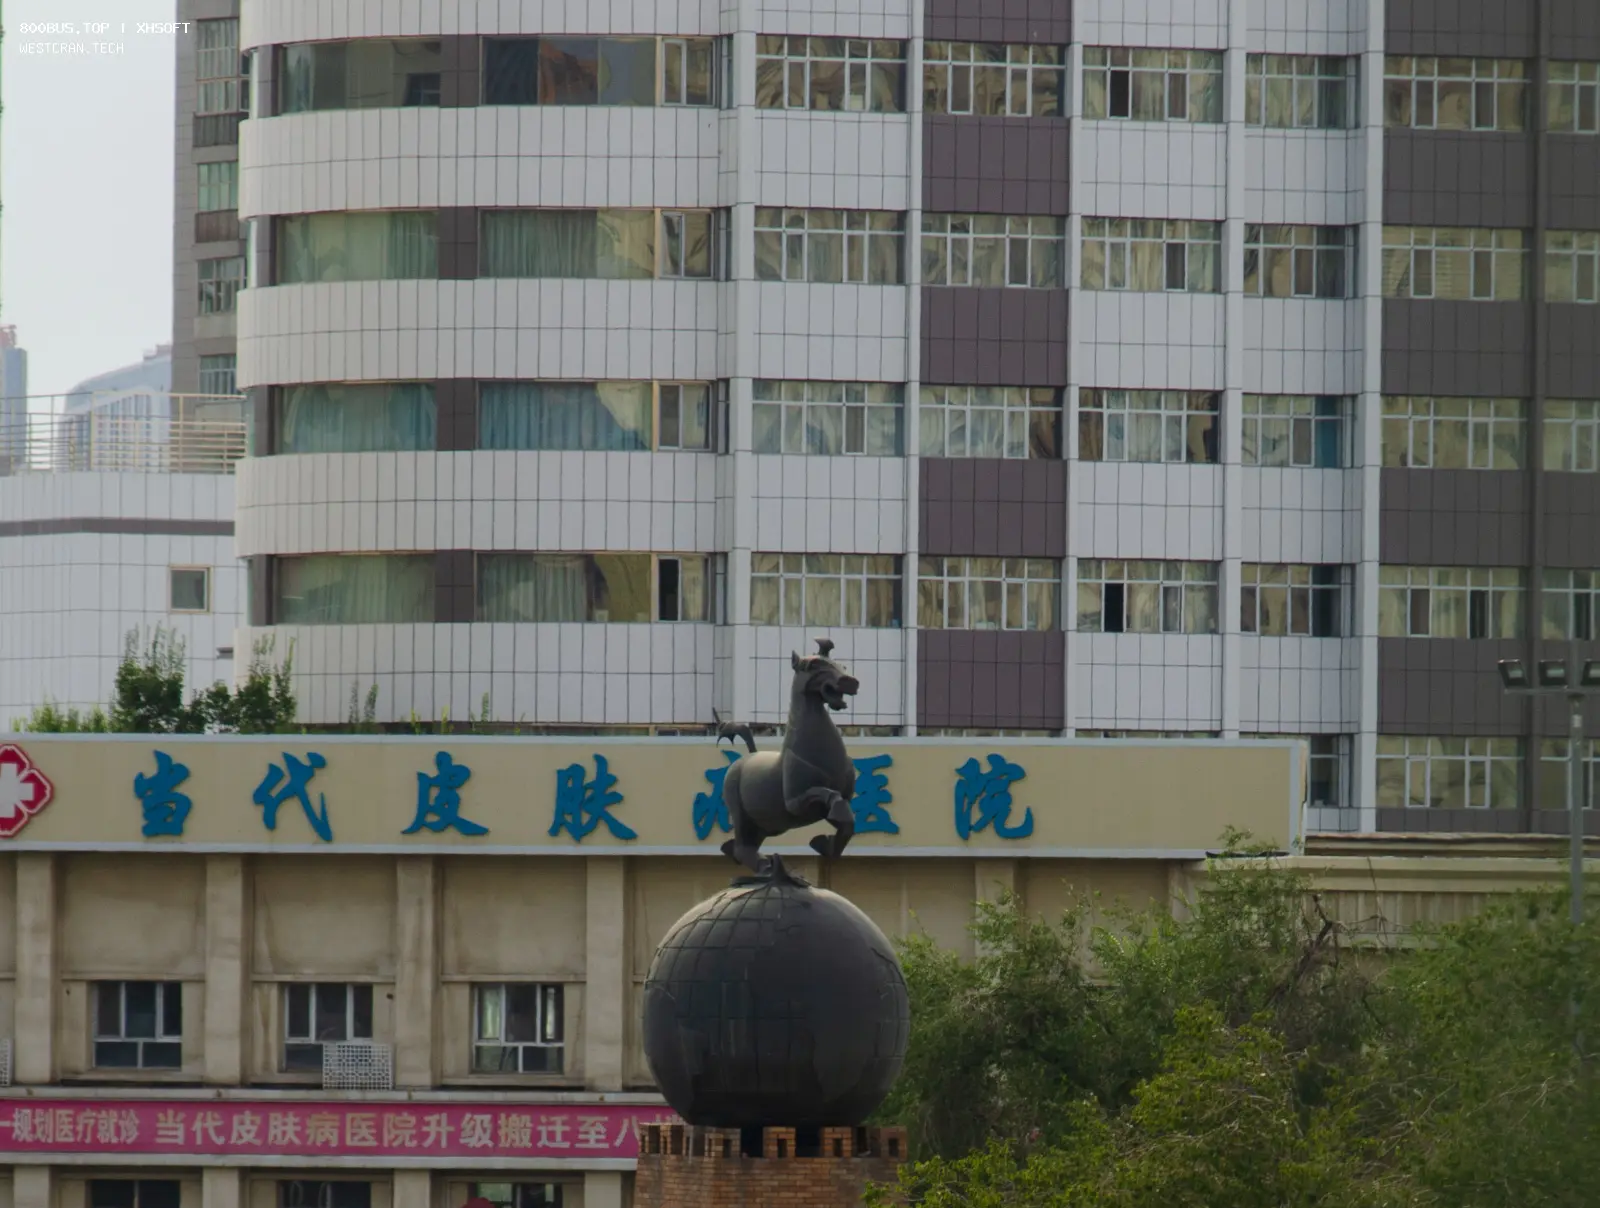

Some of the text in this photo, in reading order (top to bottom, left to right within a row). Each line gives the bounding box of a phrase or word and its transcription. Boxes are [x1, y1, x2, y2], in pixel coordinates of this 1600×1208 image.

[155, 1109, 684, 1149] 当代皮肤病医院升级搬迁至八
